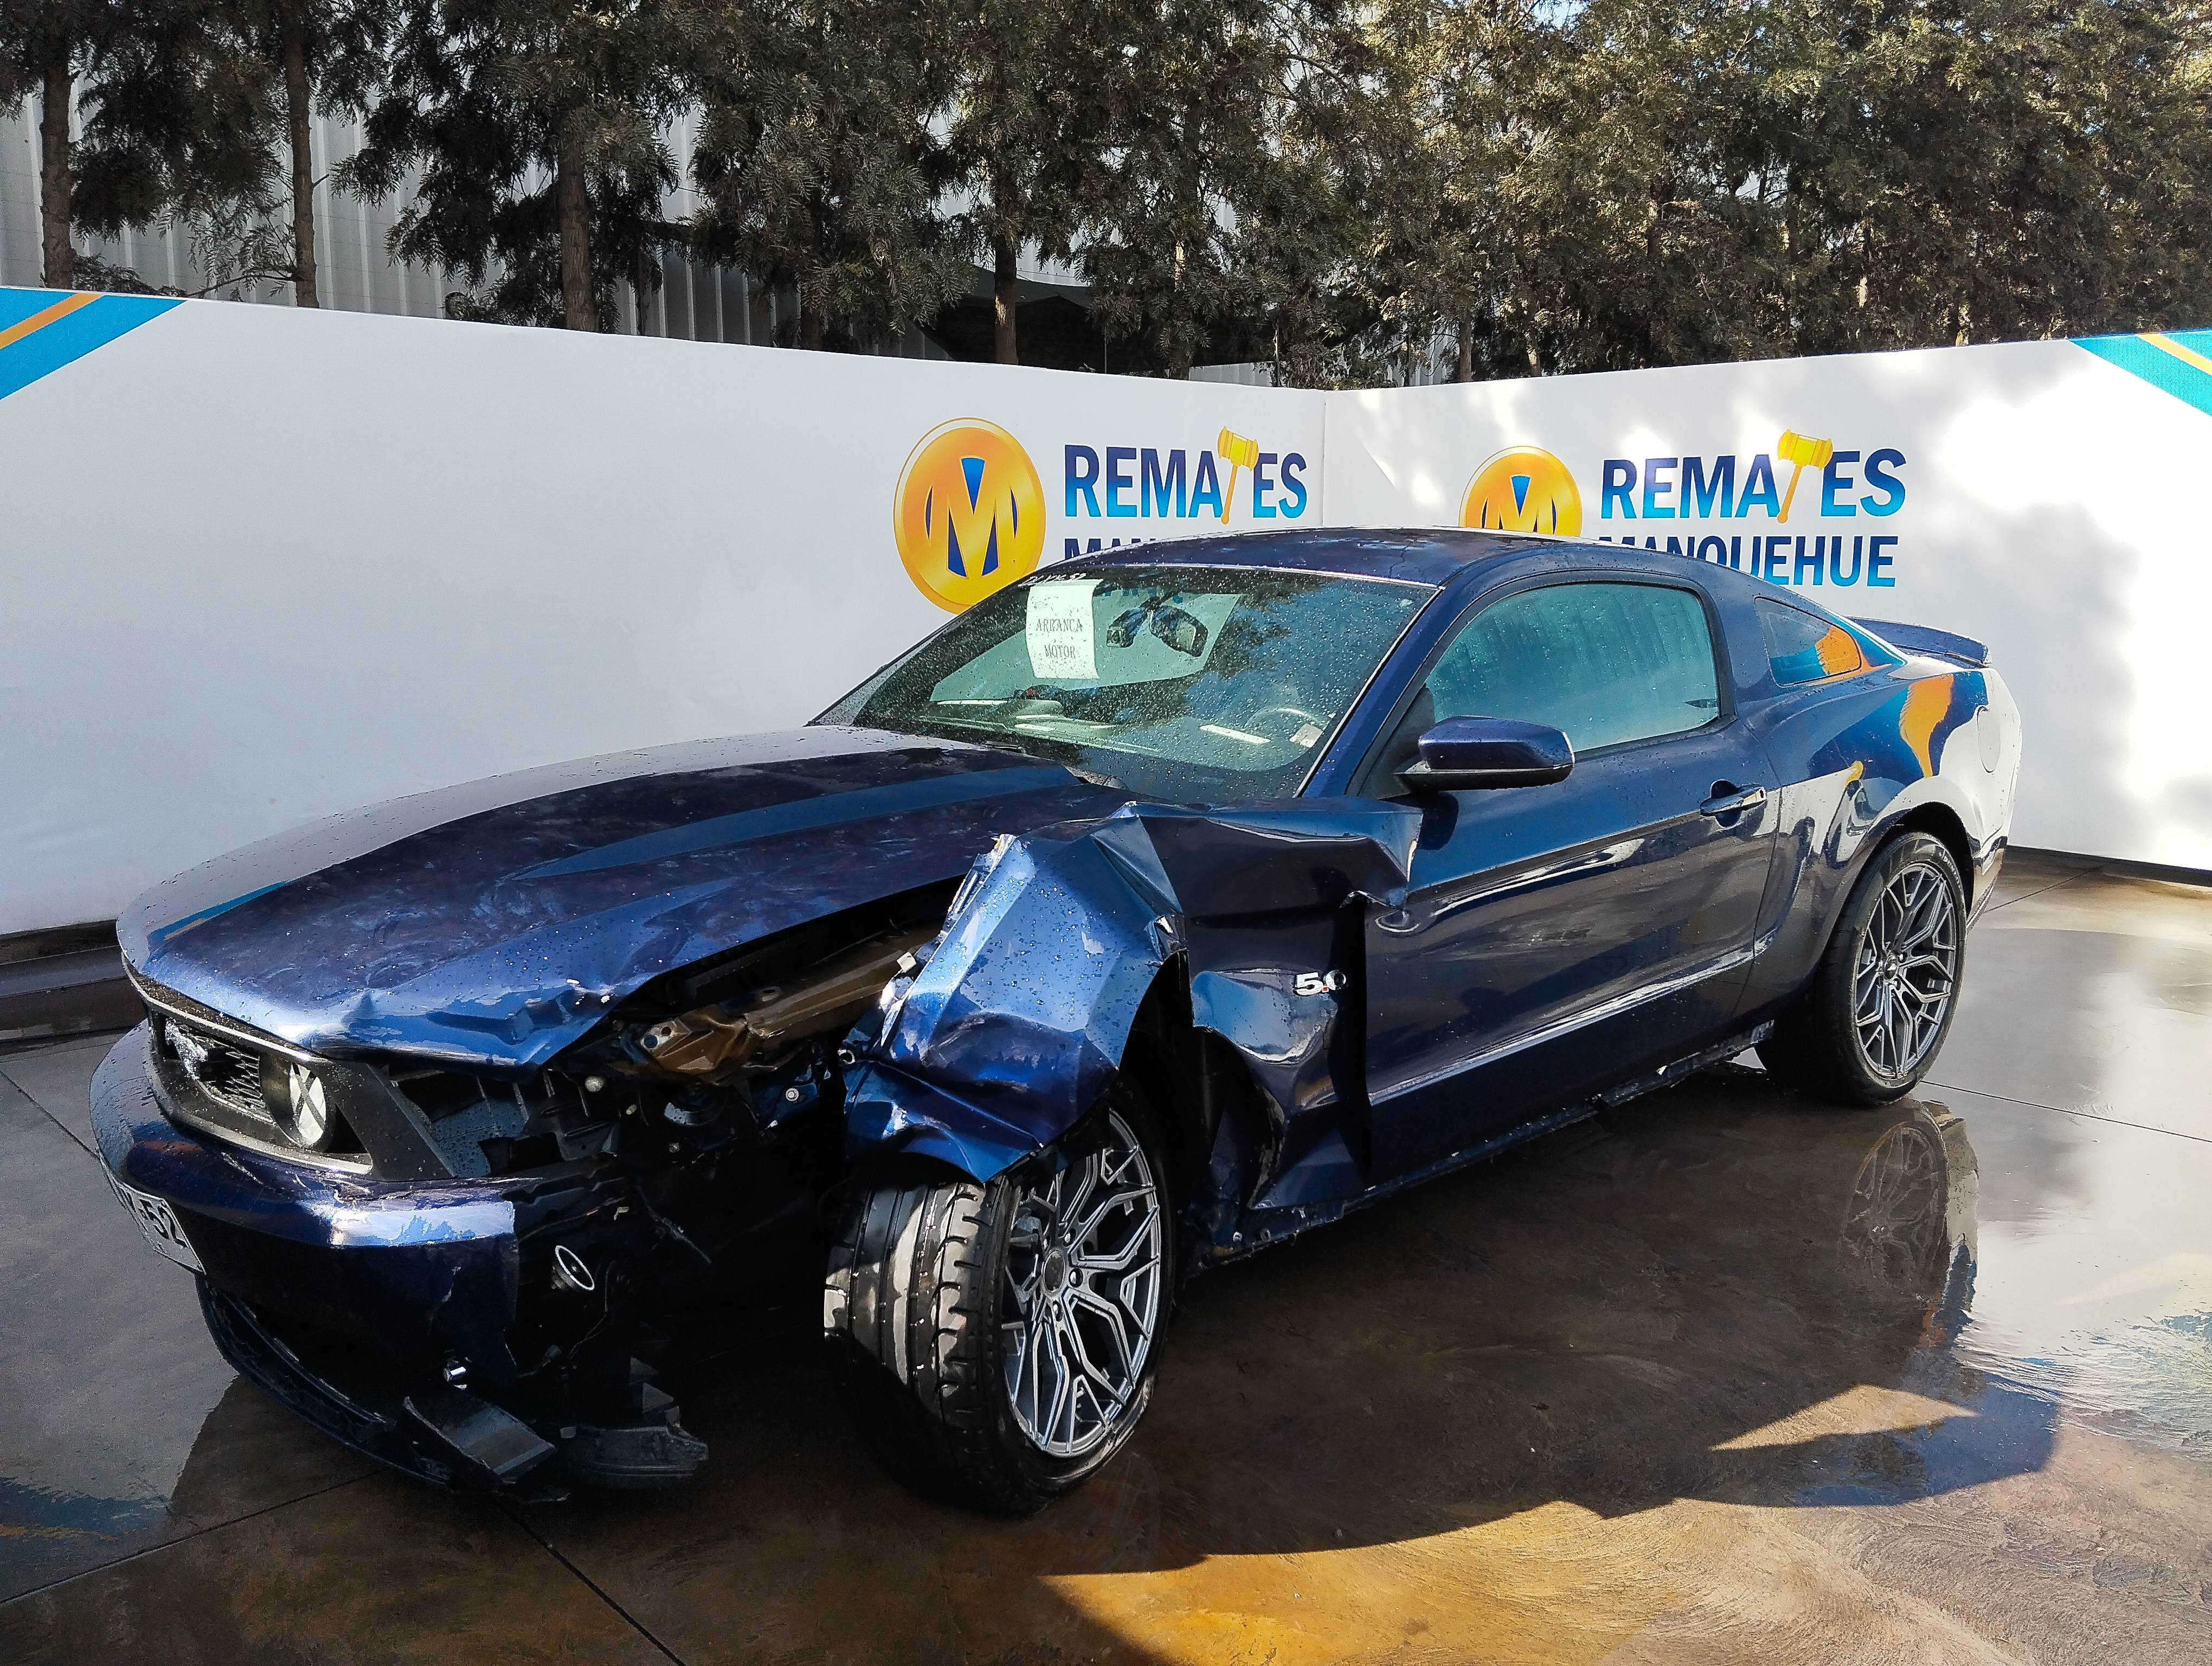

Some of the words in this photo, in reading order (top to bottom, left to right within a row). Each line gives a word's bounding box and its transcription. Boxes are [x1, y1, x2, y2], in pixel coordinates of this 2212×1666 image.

[1064, 426, 1308, 524] REMATES
[1601, 428, 1907, 524] REMATES
[1599, 535, 1898, 587] QUEHUE
[1036, 618, 1083, 632] ARRANCA
[1044, 644, 1076, 659] MOTOR
